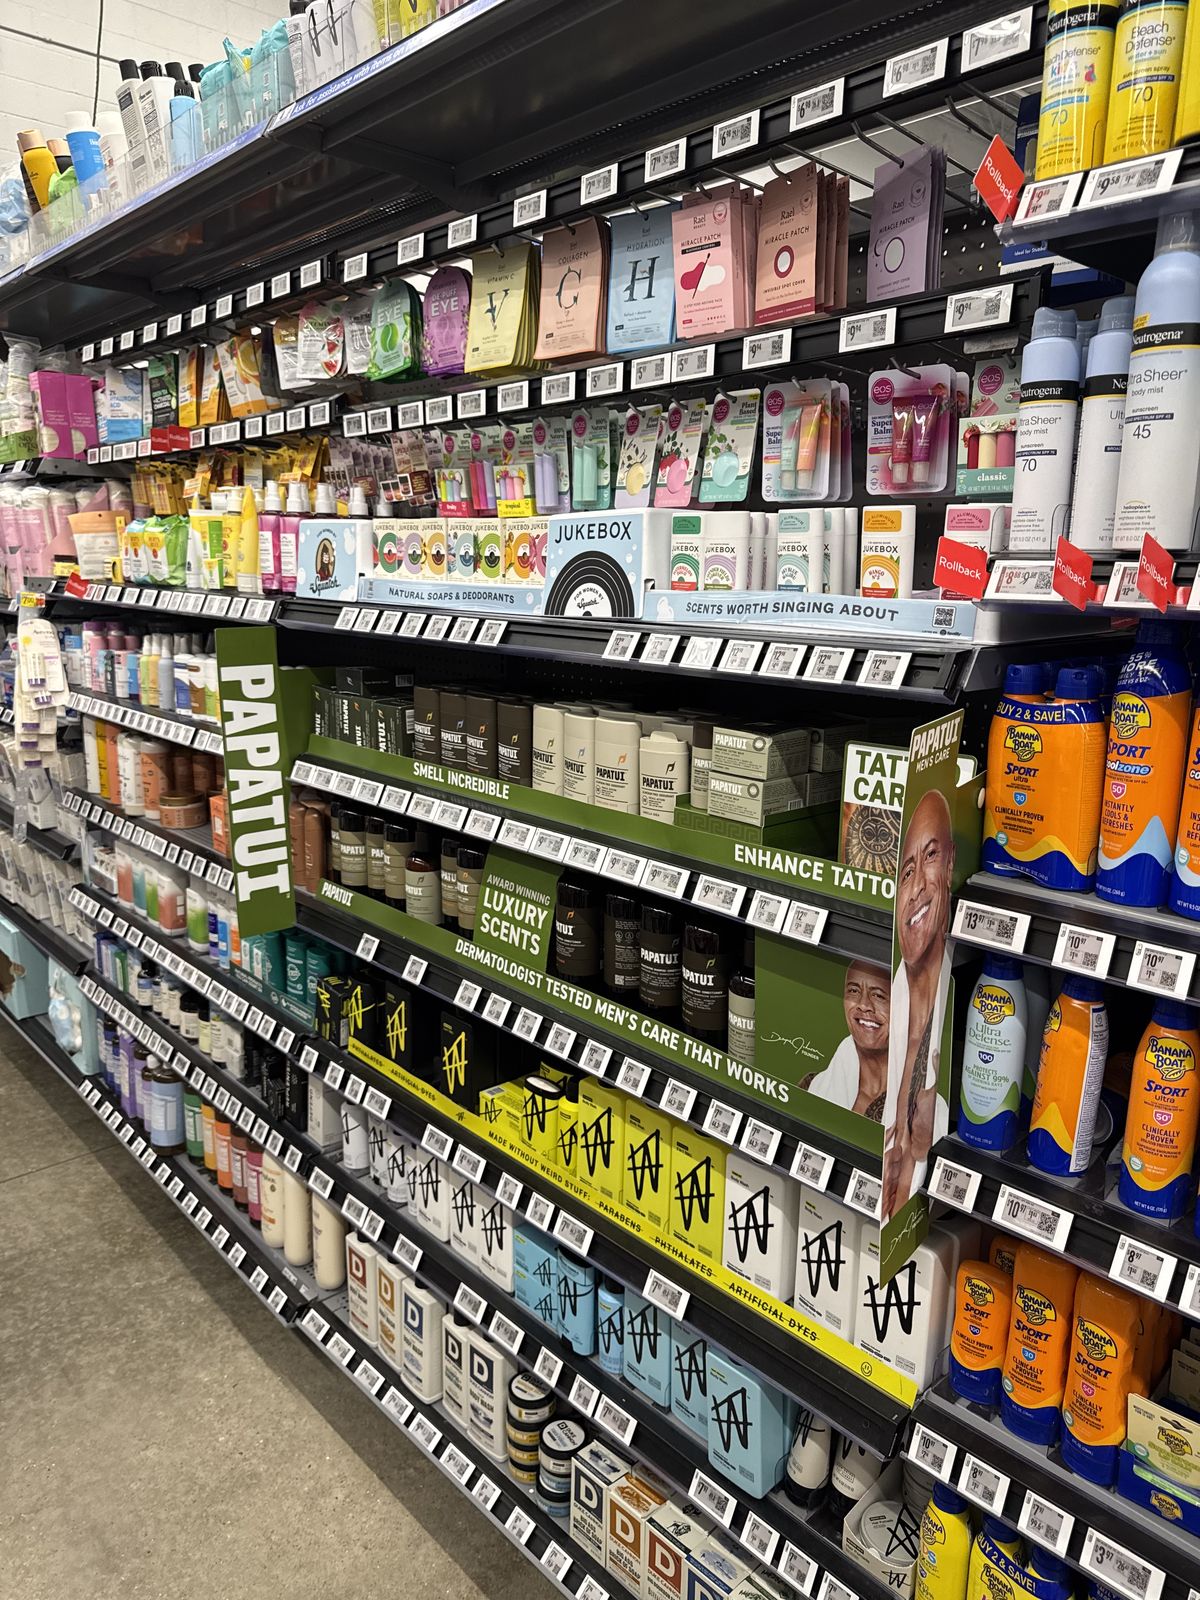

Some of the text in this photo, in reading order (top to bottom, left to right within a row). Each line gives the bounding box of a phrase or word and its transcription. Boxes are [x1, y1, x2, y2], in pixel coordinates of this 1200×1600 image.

[1131, 20, 1169, 39] Beach
[1125, 36, 1173, 54] Defense
[318, 78, 352, 100] assistance
[354, 66, 370, 81] with
[371, 56, 392, 72] items
[1134, 86, 1153, 103] 70
[1051, 109, 1068, 127] 70
[985, 156, 1013, 203] Rollback
[693, 214, 706, 225] Rael
[780, 207, 795, 221] Rael
[900, 216, 915, 227] PATCH
[681, 233, 721, 247] MIRACLE PATCH
[764, 225, 810, 246] MIRACLE PATCH
[626, 237, 665, 253] HYDRATION
[557, 250, 590, 266] COLLAGEN
[792, 279, 806, 287] COVER
[431, 297, 460, 318] EYE
[377, 309, 403, 328] EYE
[1133, 331, 1181, 345] Neutrogena
[981, 373, 1001, 384] eos
[1143, 369, 1185, 383] Sheer
[873, 385, 892, 394] eos
[1131, 386, 1164, 397] body mist
[767, 398, 783, 406] eos
[739, 408, 757, 416] Based
[1030, 415, 1059, 425] Sheer
[1034, 427, 1048, 435] mist
[1132, 424, 1151, 440] 45
[1021, 458, 1037, 472] 70
[977, 472, 1008, 482] classic
[554, 520, 632, 544] JUKEBOX
[705, 546, 736, 554] JUKEBOX
[862, 545, 898, 554] JUKEBOX
[939, 557, 982, 581] Rollback
[1056, 558, 1087, 589] Rollback
[1141, 558, 1168, 590] Rollback
[389, 587, 515, 604] NATURAL SOAPS & DEODORANTS
[582, 587, 599, 595] WOMEN
[685, 601, 899, 622] SCENTS WORTH SINGING ABOUT
[996, 701, 1031, 720] BUY 2 &
[1114, 710, 1138, 725] BOAT
[441, 731, 462, 744] PAPATUI
[715, 734, 748, 749] PAPATUI
[911, 717, 961, 763] PAPATUI
[1008, 727, 1040, 742] BANANA
[1013, 738, 1034, 751] BOAT
[1107, 738, 1151, 759] SPORT
[533, 750, 554, 764] PAPATUI
[856, 750, 909, 779] TAT
[934, 748, 951, 766] CARE
[564, 759, 585, 774] PAPATUI
[596, 766, 626, 781] PAPATUI
[1004, 763, 1039, 778] SPORT
[220, 663, 291, 903] PAPATUI
[413, 761, 510, 800] SMELL INCREDIBLE
[642, 777, 675, 791] PAPATUI
[711, 779, 742, 796] PAPATUI
[1013, 776, 1029, 784] ultra
[853, 778, 905, 807] CAR
[1015, 794, 1025, 802] 30
[995, 806, 1044, 822] CLINICALLY PROVEN
[1104, 810, 1129, 821] COOLS &
[734, 843, 895, 899] ENHANCE TATTO
[321, 882, 354, 907] PAPATUI
[487, 874, 551, 906] AWARD WINNING
[483, 888, 548, 930] LUXURY
[480, 913, 541, 956] SCENTS
[640, 948, 679, 965] PAPATUI
[977, 984, 1012, 1004] BANANA
[979, 999, 1004, 1012] BOAT
[456, 938, 543, 989] DERMATOLOGIST
[546, 978, 592, 1010] TESTED
[595, 998, 638, 1031] MEN'S
[640, 1020, 679, 1050] CARE
[683, 1038, 722, 1070] THAT
[727, 1059, 790, 1103] WORKS
[968, 1028, 1010, 1047] Defense
[975, 1022, 1002, 1037] Ultra
[801, 1050, 819, 1060] FOUNDER
[1150, 1038, 1192, 1058] BANANA
[978, 1052, 993, 1062] 100
[1155, 1053, 1185, 1068] BOAT
[964, 1065, 991, 1081] AGAINST
[992, 1074, 1010, 1084] 99%
[973, 1063, 998, 1076] PROTECTS
[420, 1086, 436, 1101] DYES
[1144, 1079, 1189, 1098] SPORT
[1155, 1094, 1176, 1104] ultra
[1141, 1123, 1181, 1138] CLINICALLY
[1145, 1131, 1175, 1145] PROVEN
[488, 1130, 819, 1342] MADE WITHOUT WEIRD STUFF: PARABENS PHTHALATES ARTIFICIAL DYES
[967, 1276, 993, 1297] BANANA
[970, 1288, 987, 1300] BOAT
[1018, 1287, 1052, 1310] BANANA
[964, 1302, 991, 1319] SPORT
[1022, 1301, 1044, 1316] BOAT
[1014, 1318, 1052, 1342] SPORT
[1079, 1319, 1113, 1347] BANANA
[1022, 1334, 1039, 1345] ultra
[1082, 1332, 1105, 1350] BOAT
[1024, 1350, 1034, 1359] 30
[1012, 1356, 1044, 1375] CLINICALLY
[1015, 1364, 1039, 1380] PROVEN
[1075, 1352, 1112, 1378] SPORT
[1082, 1367, 1098, 1380] ultra
[1073, 1390, 1103, 1412] CLINICALLY
[1075, 1399, 1098, 1416] PROVEN
[1159, 1427, 1189, 1449] BANANA
[1166, 1438, 1185, 1451] BOAT
[1152, 1494, 1182, 1510] BANANA
[977, 1533, 1037, 1594] BUY 2 & SAVE!
[986, 1567, 1013, 1596] BANANA
[988, 1580, 1007, 1597] BOAT
